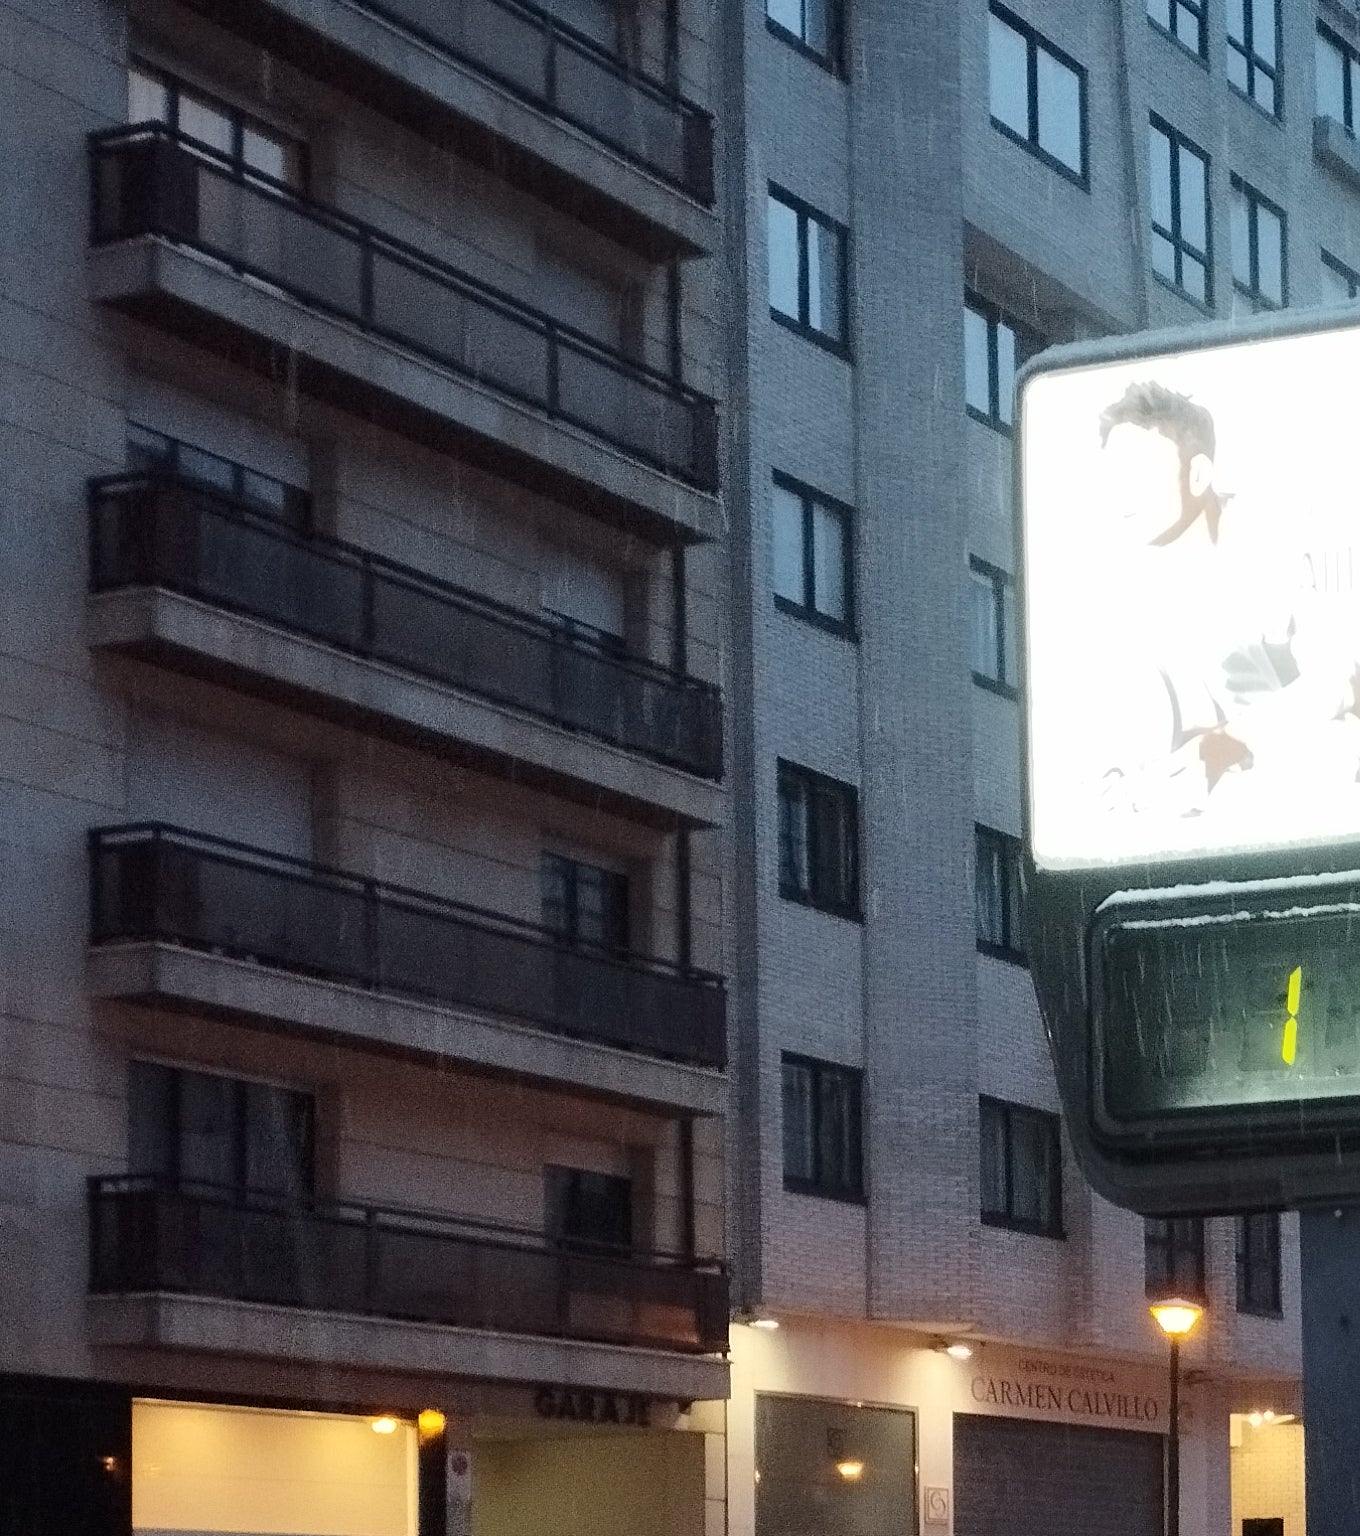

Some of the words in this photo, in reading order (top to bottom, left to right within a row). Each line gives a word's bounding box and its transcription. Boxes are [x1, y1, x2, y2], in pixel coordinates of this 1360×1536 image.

[534, 1389, 651, 1427] GARAJE
[970, 1377, 1062, 1410] CARMEN
[1067, 1388, 1158, 1421] CALVILLO
